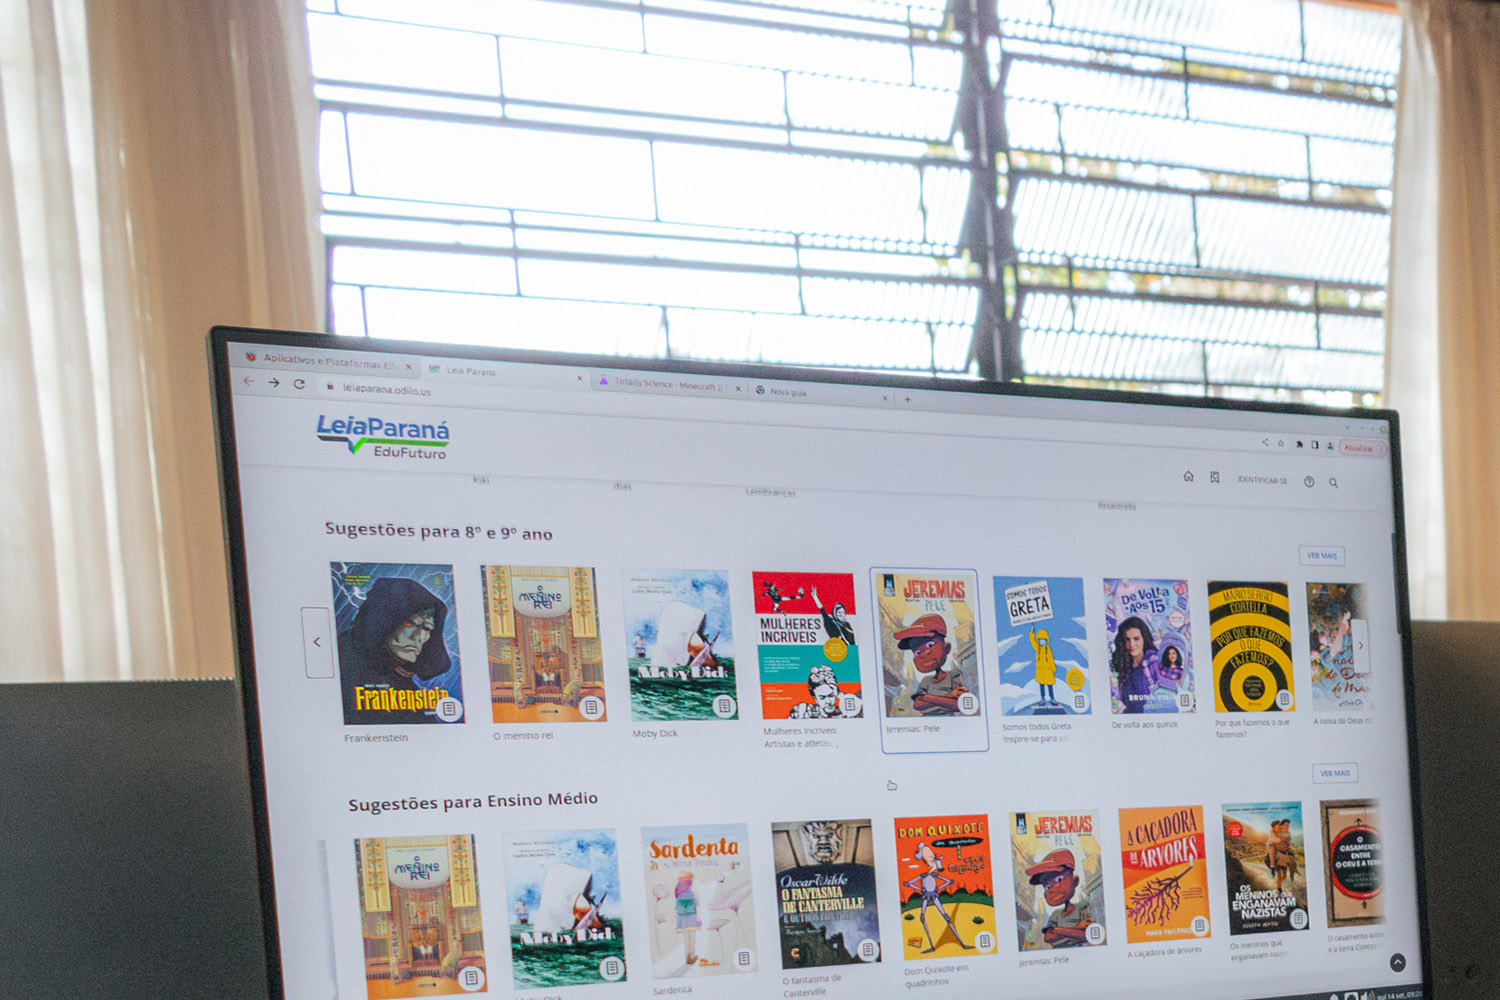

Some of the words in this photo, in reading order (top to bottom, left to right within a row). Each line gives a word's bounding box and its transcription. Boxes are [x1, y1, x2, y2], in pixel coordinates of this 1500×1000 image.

[264, 354, 315, 365] Aplicativos
[326, 358, 380, 369] Plataformas
[447, 366, 464, 375] Leia
[343, 382, 432, 396] leiaparana.odilo.us
[615, 377, 642, 387] Totally
[644, 380, 673, 388] Science
[680, 382, 715, 391] Minecraft
[770, 388, 789, 396] Nova
[317, 415, 450, 439] LeiaParaná
[374, 445, 446, 459] EduFuturo
[325, 521, 416, 539] Sugestões
[421, 525, 460, 542] para
[487, 530, 496, 540] e
[522, 528, 553, 541] ano
[1307, 552, 1320, 560] VER
[1322, 552, 1338, 560] MAIS
[904, 580, 965, 598] JEREMIAS
[1011, 596, 1049, 617] GRETA
[1149, 599, 1165, 613] 15
[1230, 601, 1267, 613] CORTELLA
[761, 618, 820, 629] MULHERES
[1250, 627, 1285, 647] FAZEMOS
[638, 666, 690, 680] Moby
[763, 727, 802, 736] Mulheres
[1029, 723, 1049, 731] todos
[1051, 722, 1071, 730] Greta
[344, 734, 409, 743] Frankenstein
[504, 732, 539, 740] menino
[541, 731, 553, 739] rei
[633, 729, 657, 739] Moby
[660, 729, 678, 737] Dick
[1003, 736, 1039, 744] Inspire-se
[764, 740, 795, 748] Artistas
[1336, 769, 1350, 777] MAIS
[349, 796, 438, 815] Sugestões
[443, 794, 482, 813] para
[488, 793, 542, 807] Ensino
[548, 792, 598, 805] Médio
[899, 827, 922, 838] DOM
[927, 823, 983, 836] QUIXOTE
[1035, 816, 1092, 834] JEREMIAS
[1136, 808, 1197, 844] CAÇADORA
[650, 834, 738, 859] Sardenta
[781, 875, 815, 888] Oscar
[815, 873, 848, 886] Wilde
[782, 889, 789, 900] O
[791, 886, 843, 900] FANTASMA
[1236, 891, 1278, 900] MENINOS
[783, 901, 796, 913] DE
[799, 897, 864, 912] CANTERVILLE
[1232, 897, 1296, 910] ENGANAVAM
[1242, 907, 1287, 919] NAZISTAS
[1271, 940, 1282, 948] que
[1135, 950, 1166, 959] caçadora
[905, 968, 923, 976] Dom
[925, 966, 955, 974] Quixote
[783, 977, 789, 985] O
[792, 976, 829, 985] fantasma
[906, 978, 949, 989] quadrinhos
[653, 985, 692, 996] Sardenta
[784, 988, 827, 997] Canterville
